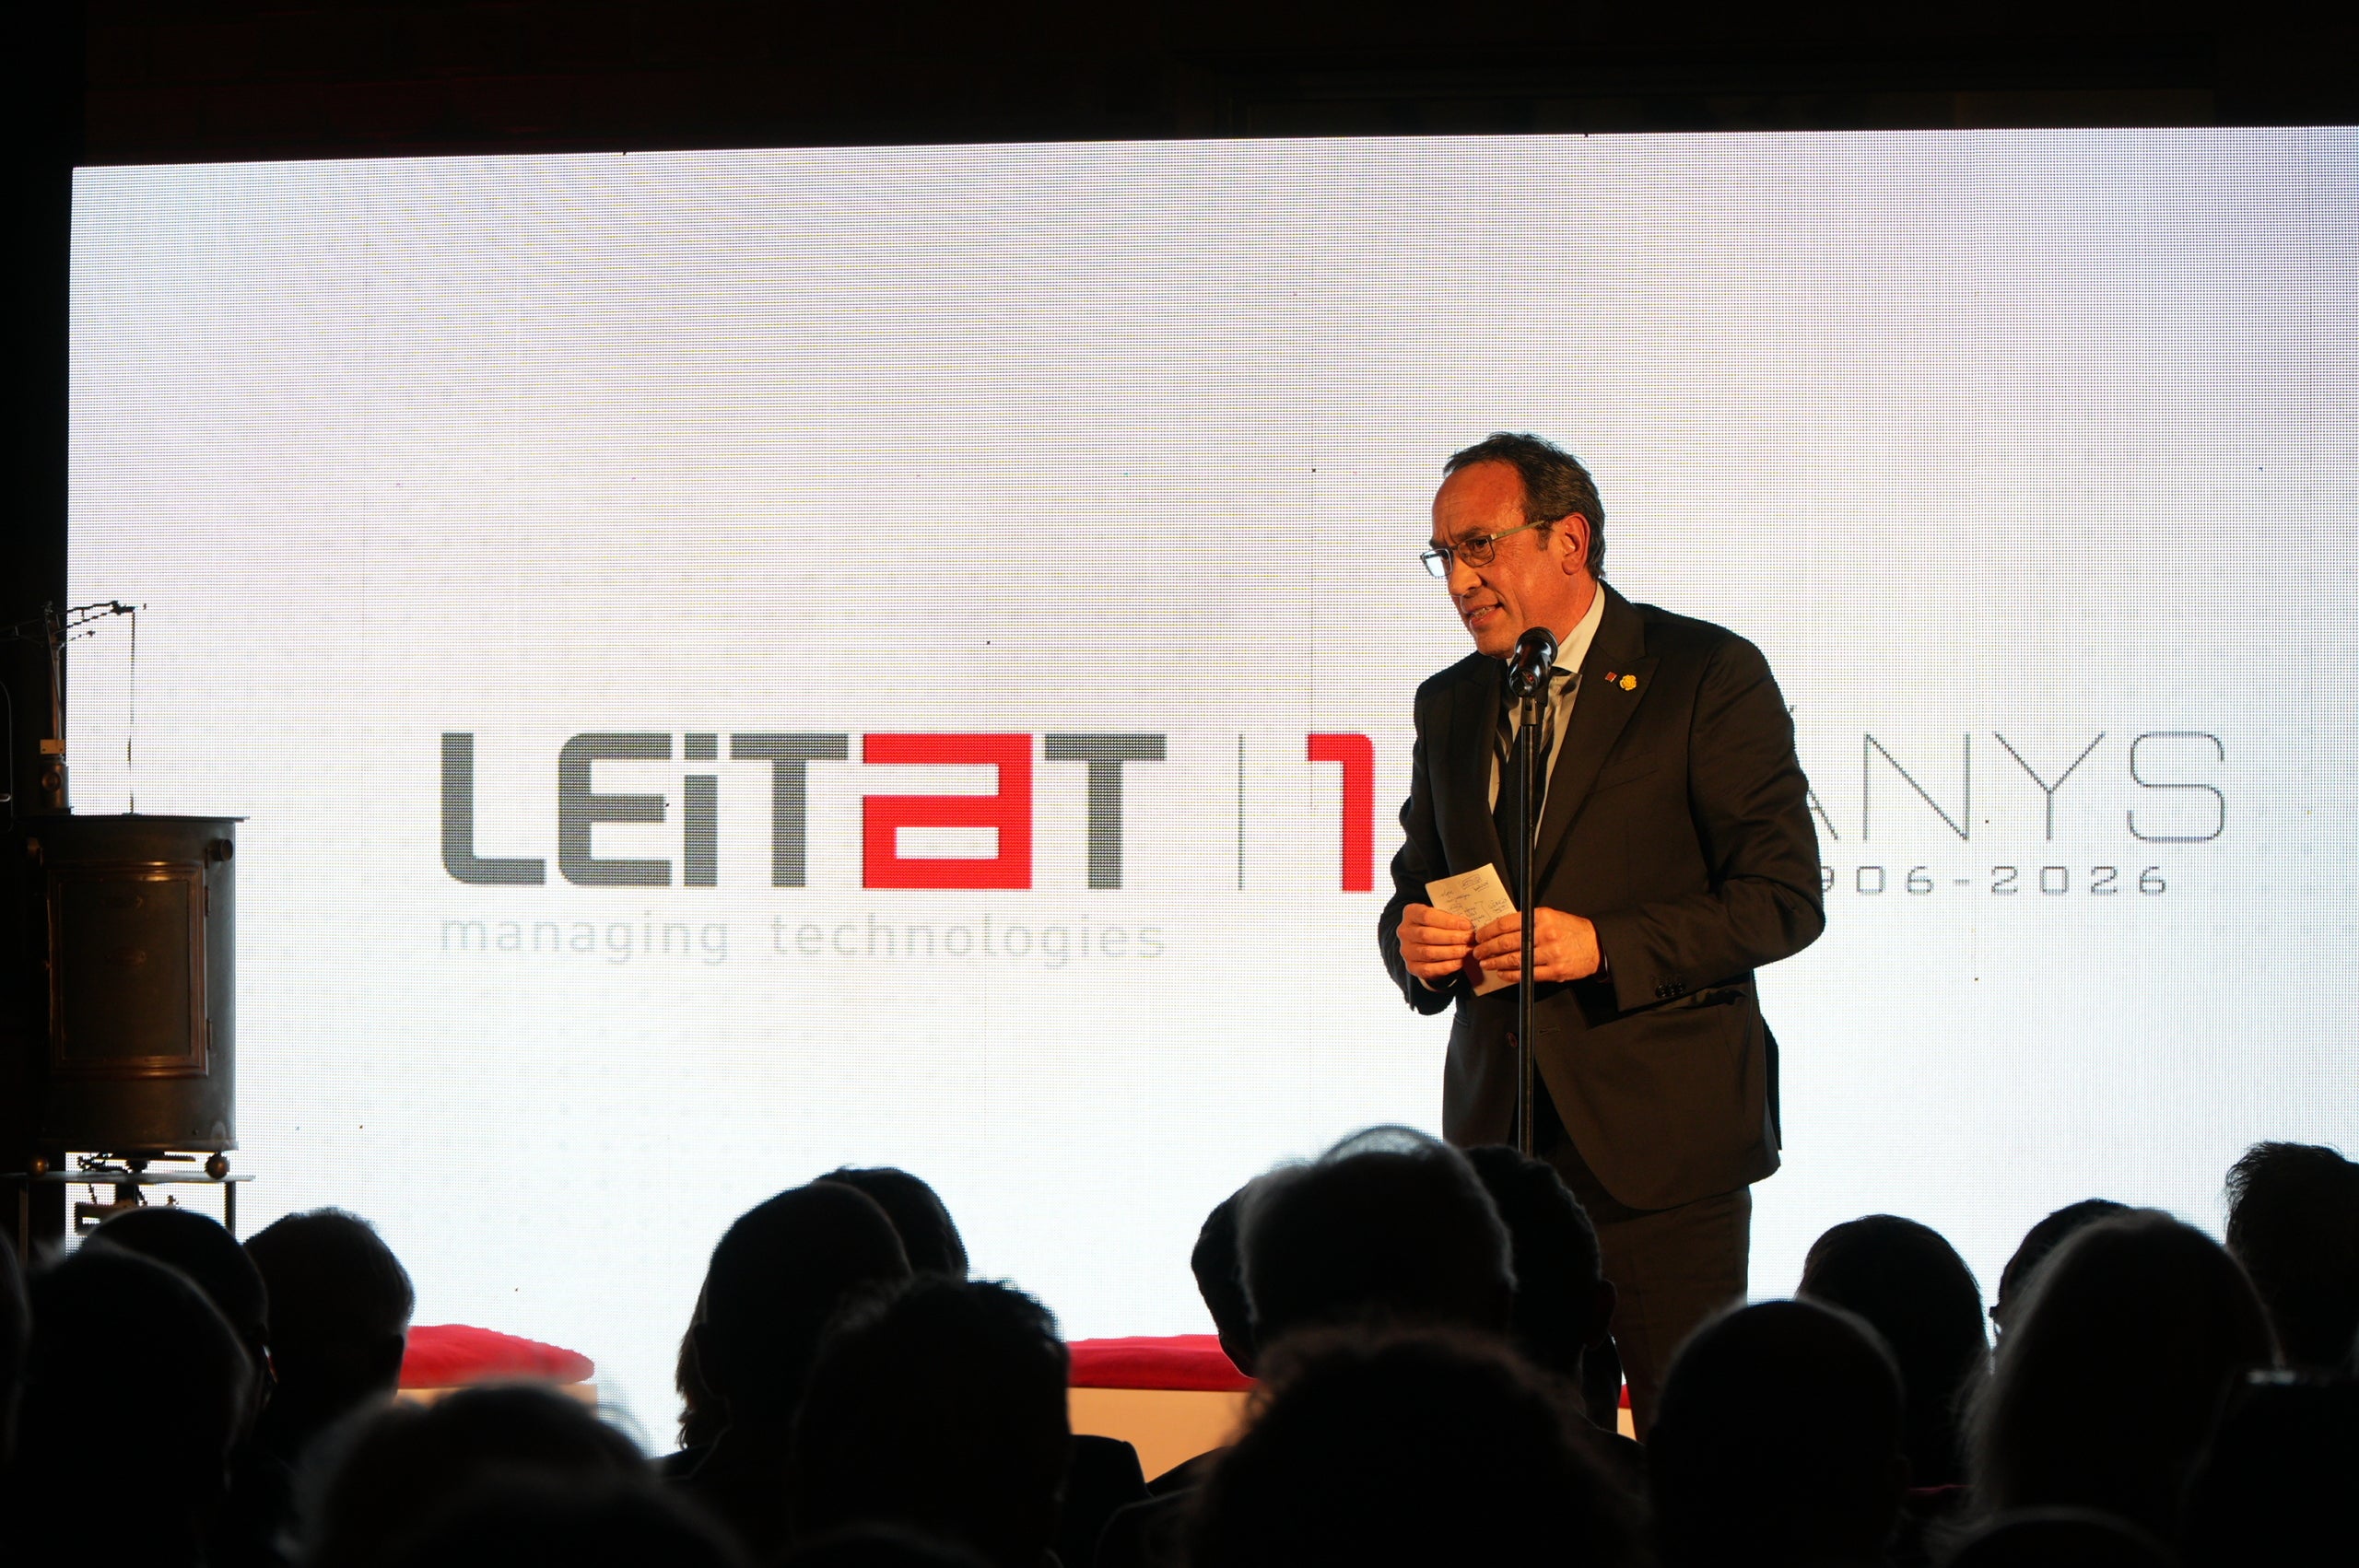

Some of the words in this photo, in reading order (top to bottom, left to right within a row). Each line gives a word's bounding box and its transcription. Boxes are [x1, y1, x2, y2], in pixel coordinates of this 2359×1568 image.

[1808, 730, 2226, 842] NYS
[441, 908, 727, 966] managing
[770, 912, 1165, 969] technologies
